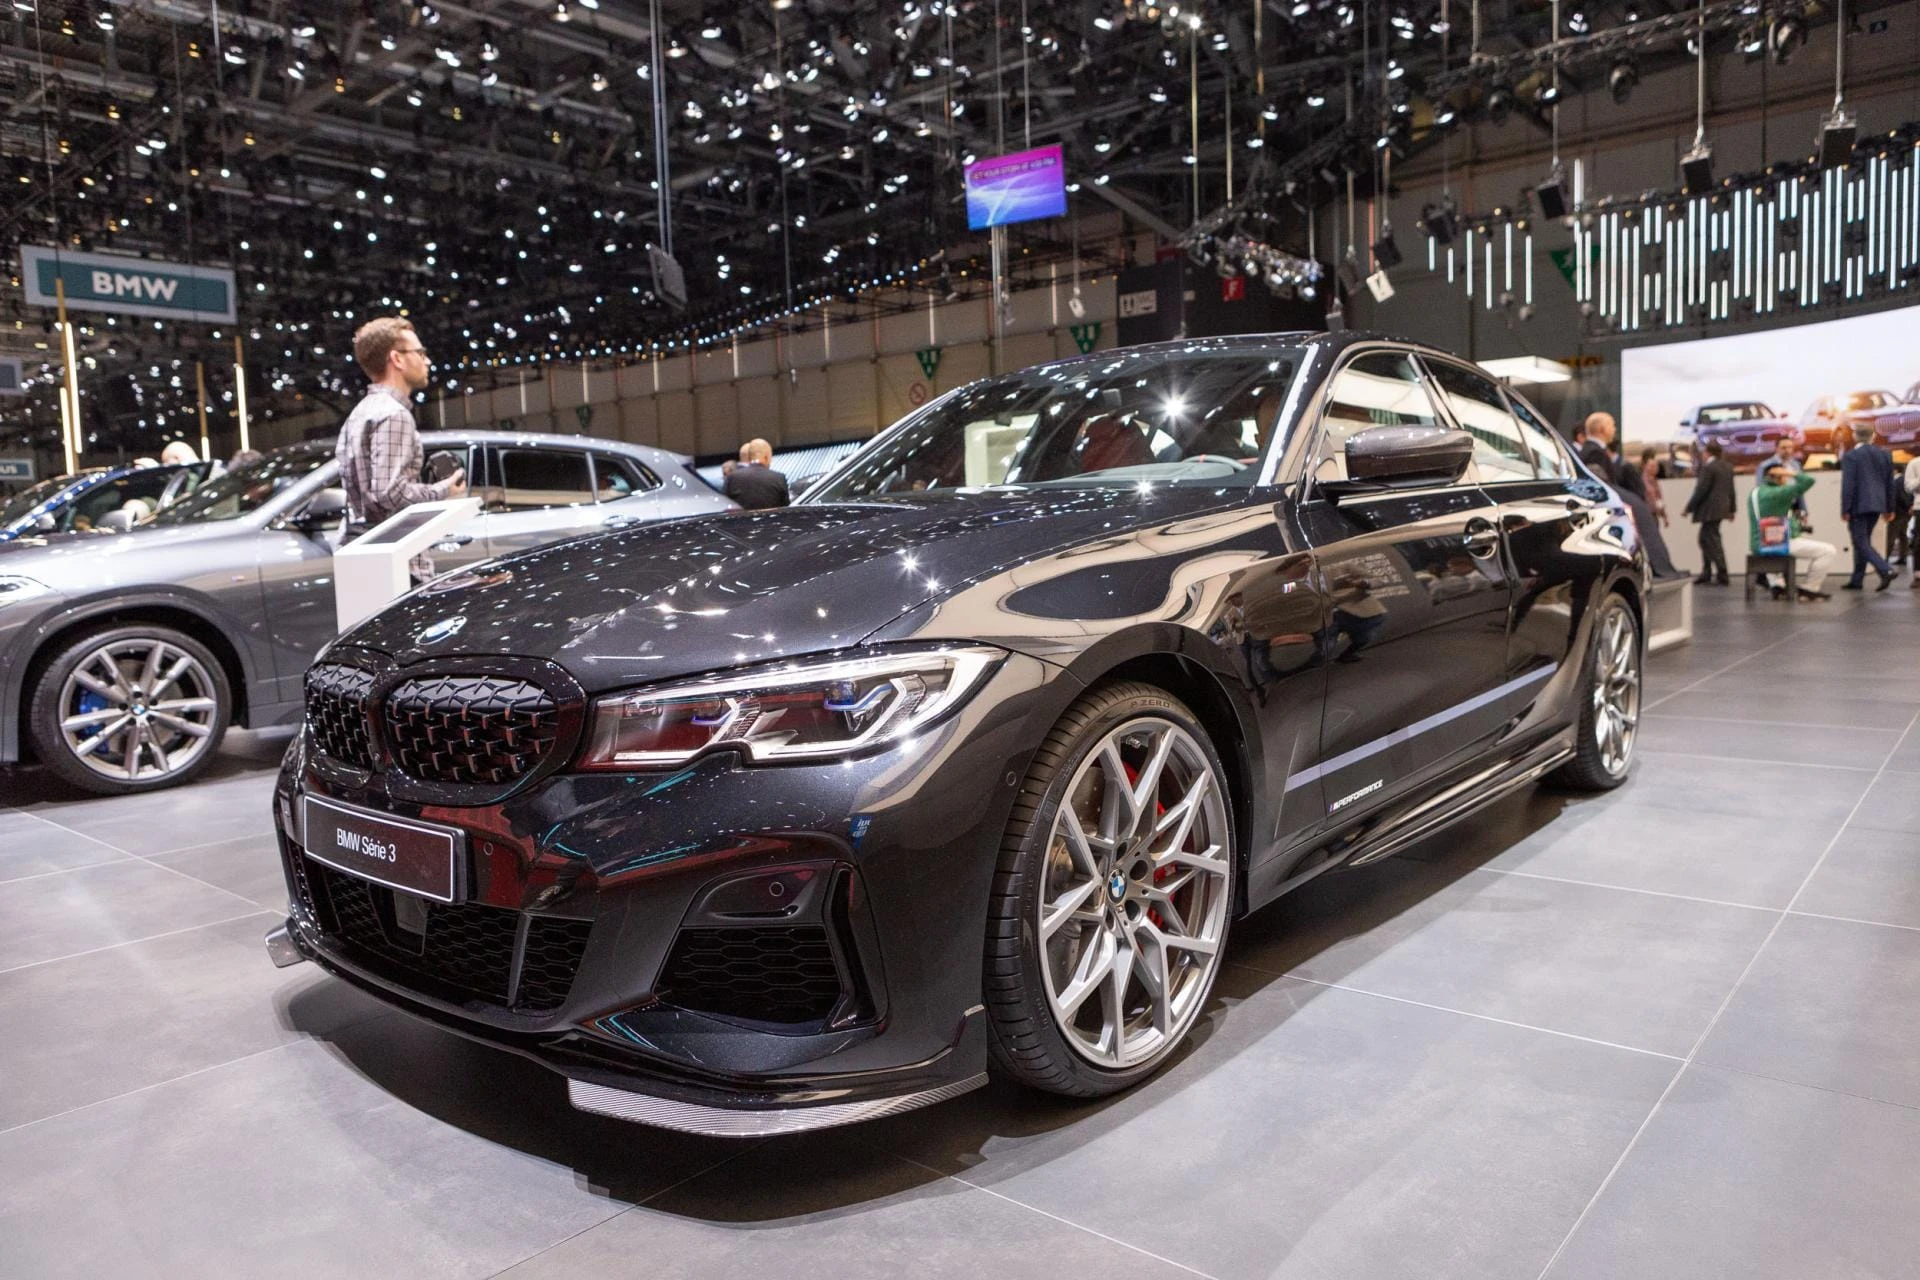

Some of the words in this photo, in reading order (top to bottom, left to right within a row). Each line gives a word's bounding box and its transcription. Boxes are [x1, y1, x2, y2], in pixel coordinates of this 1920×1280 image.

[92, 271, 178, 302] BMW
[1140, 699, 1170, 708] ZERO
[337, 827, 360, 851] BMW
[361, 836, 386, 860] Série
[388, 843, 396, 862] 3
